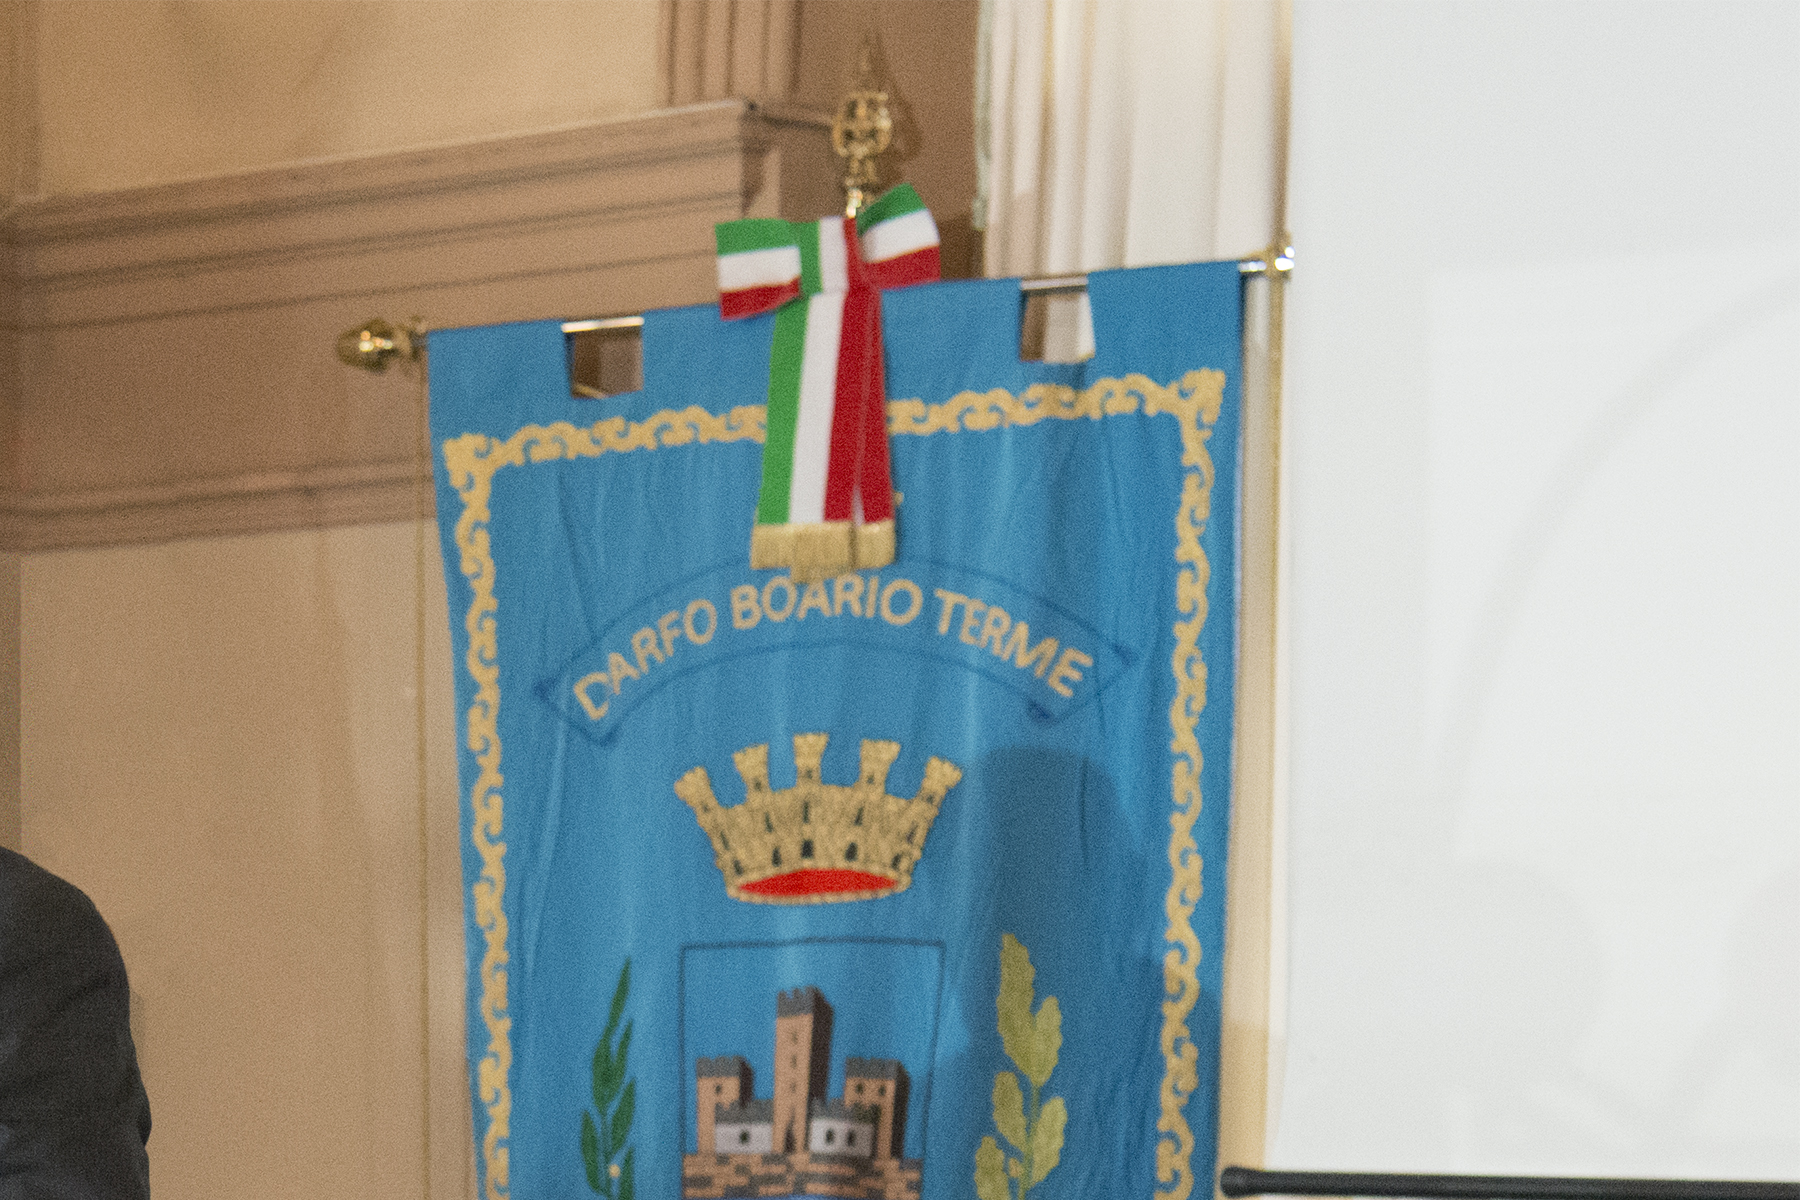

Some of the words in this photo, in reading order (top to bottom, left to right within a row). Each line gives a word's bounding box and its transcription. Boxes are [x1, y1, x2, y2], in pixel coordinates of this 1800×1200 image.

[573, 599, 717, 720] DARFO
[730, 573, 924, 630] BOARIO
[934, 588, 1094, 698] TERME
